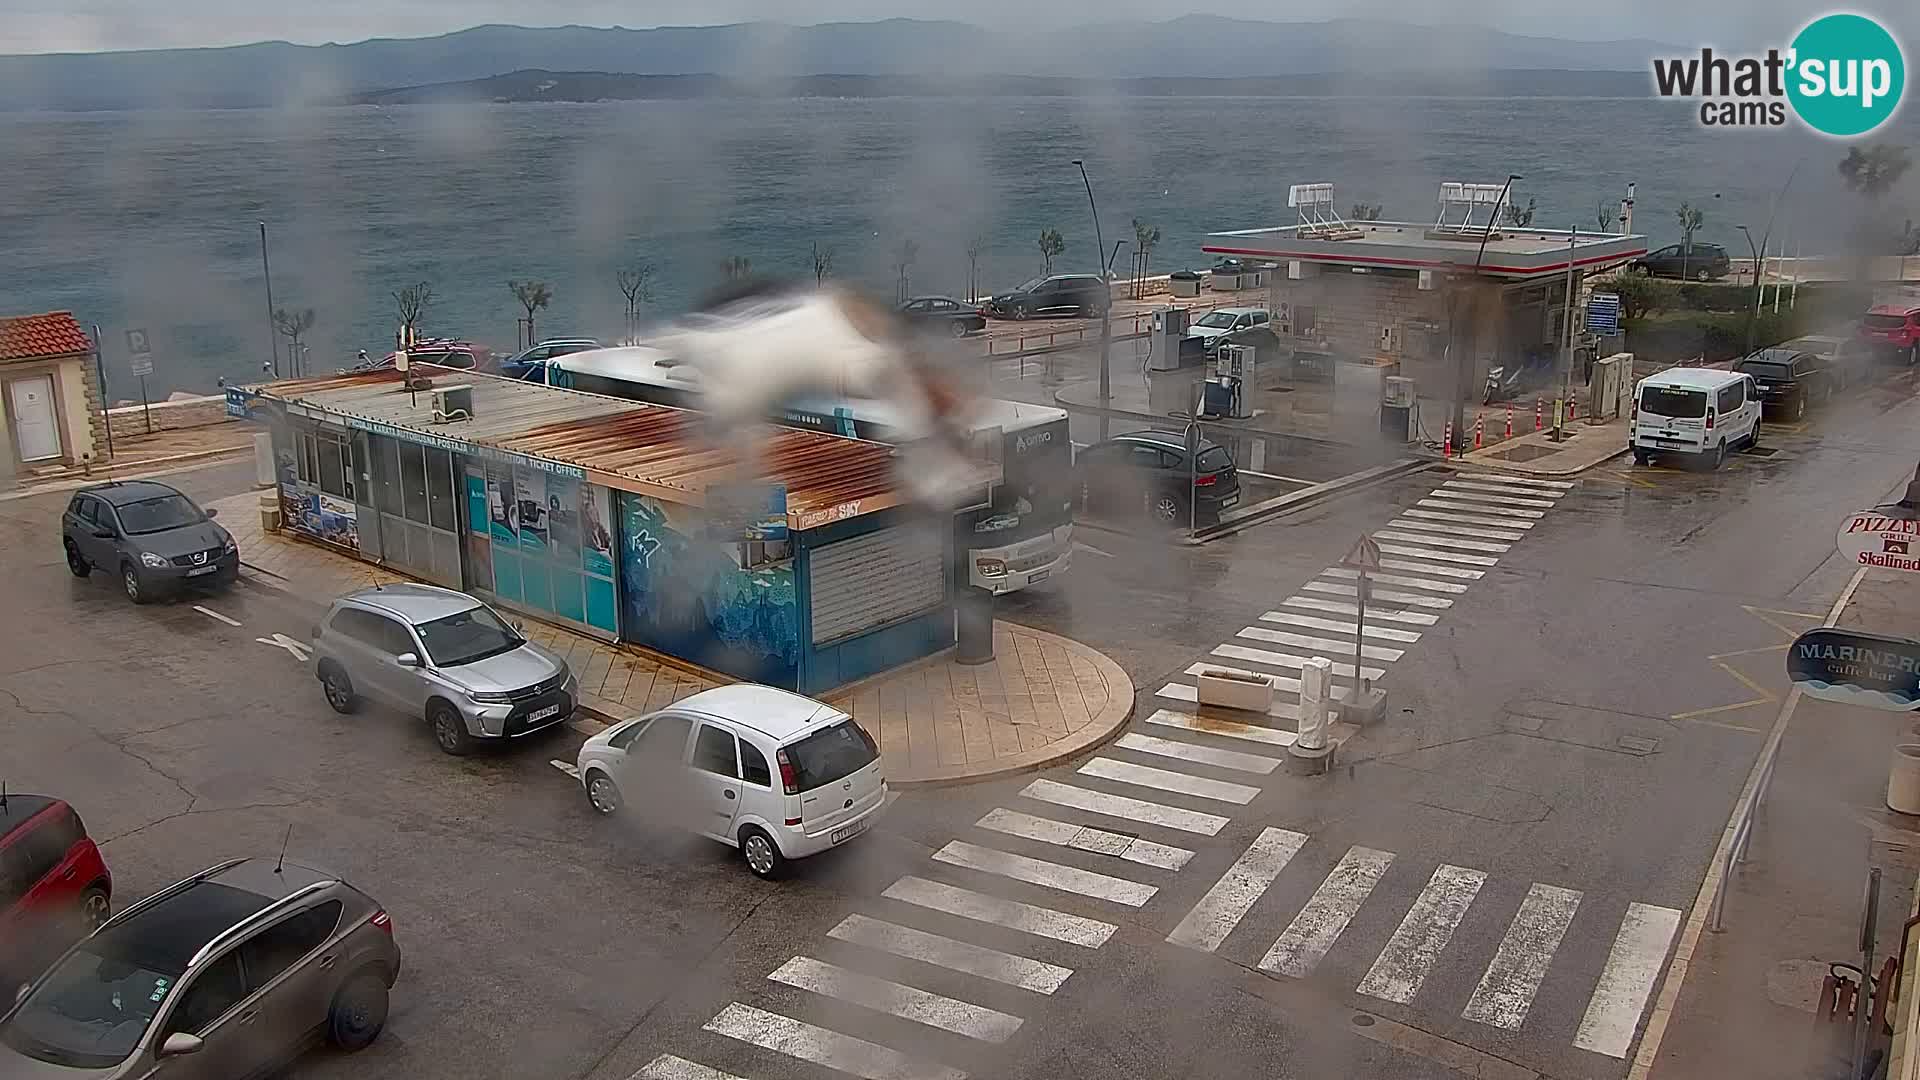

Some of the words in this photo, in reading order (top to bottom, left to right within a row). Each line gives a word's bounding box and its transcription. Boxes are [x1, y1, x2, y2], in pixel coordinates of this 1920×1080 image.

[437, 438, 468, 452] POSTAJA
[528, 459, 555, 473] TICKET
[556, 462, 583, 478] OFFICE
[1880, 532, 1916, 543] GRILL
[1857, 551, 1920, 571] Skalinad
[1869, 667, 1896, 681] bar
